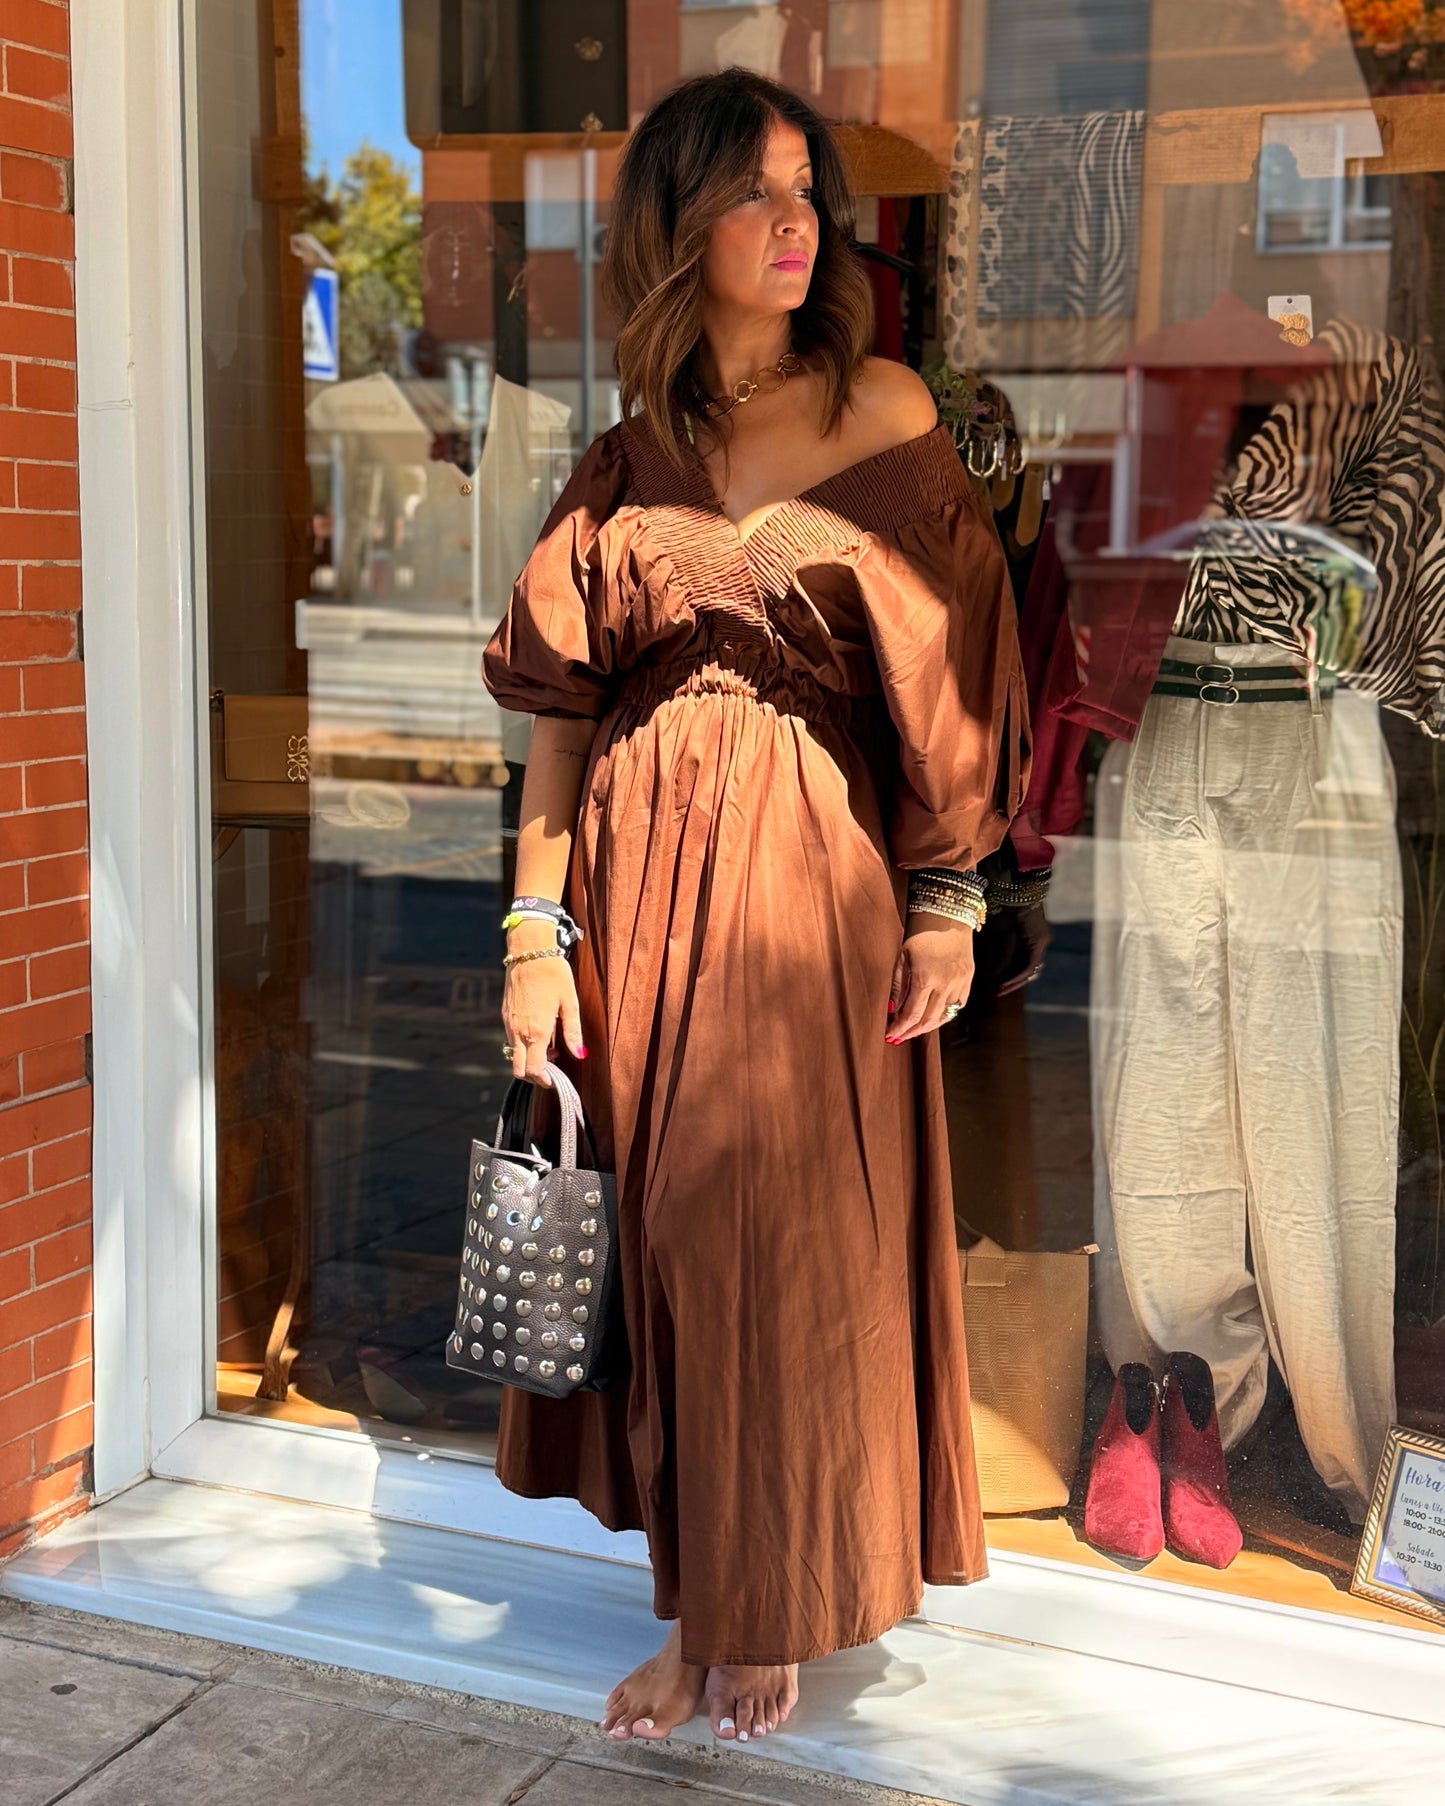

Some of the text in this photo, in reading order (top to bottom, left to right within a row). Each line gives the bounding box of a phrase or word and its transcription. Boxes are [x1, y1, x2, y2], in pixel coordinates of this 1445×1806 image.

[1405, 1466, 1445, 1492] Hora
[1406, 1507, 1426, 1520] 10:00
[1396, 1551, 1416, 1564] 10:30
[1423, 1559, 1443, 1572] 13:30
